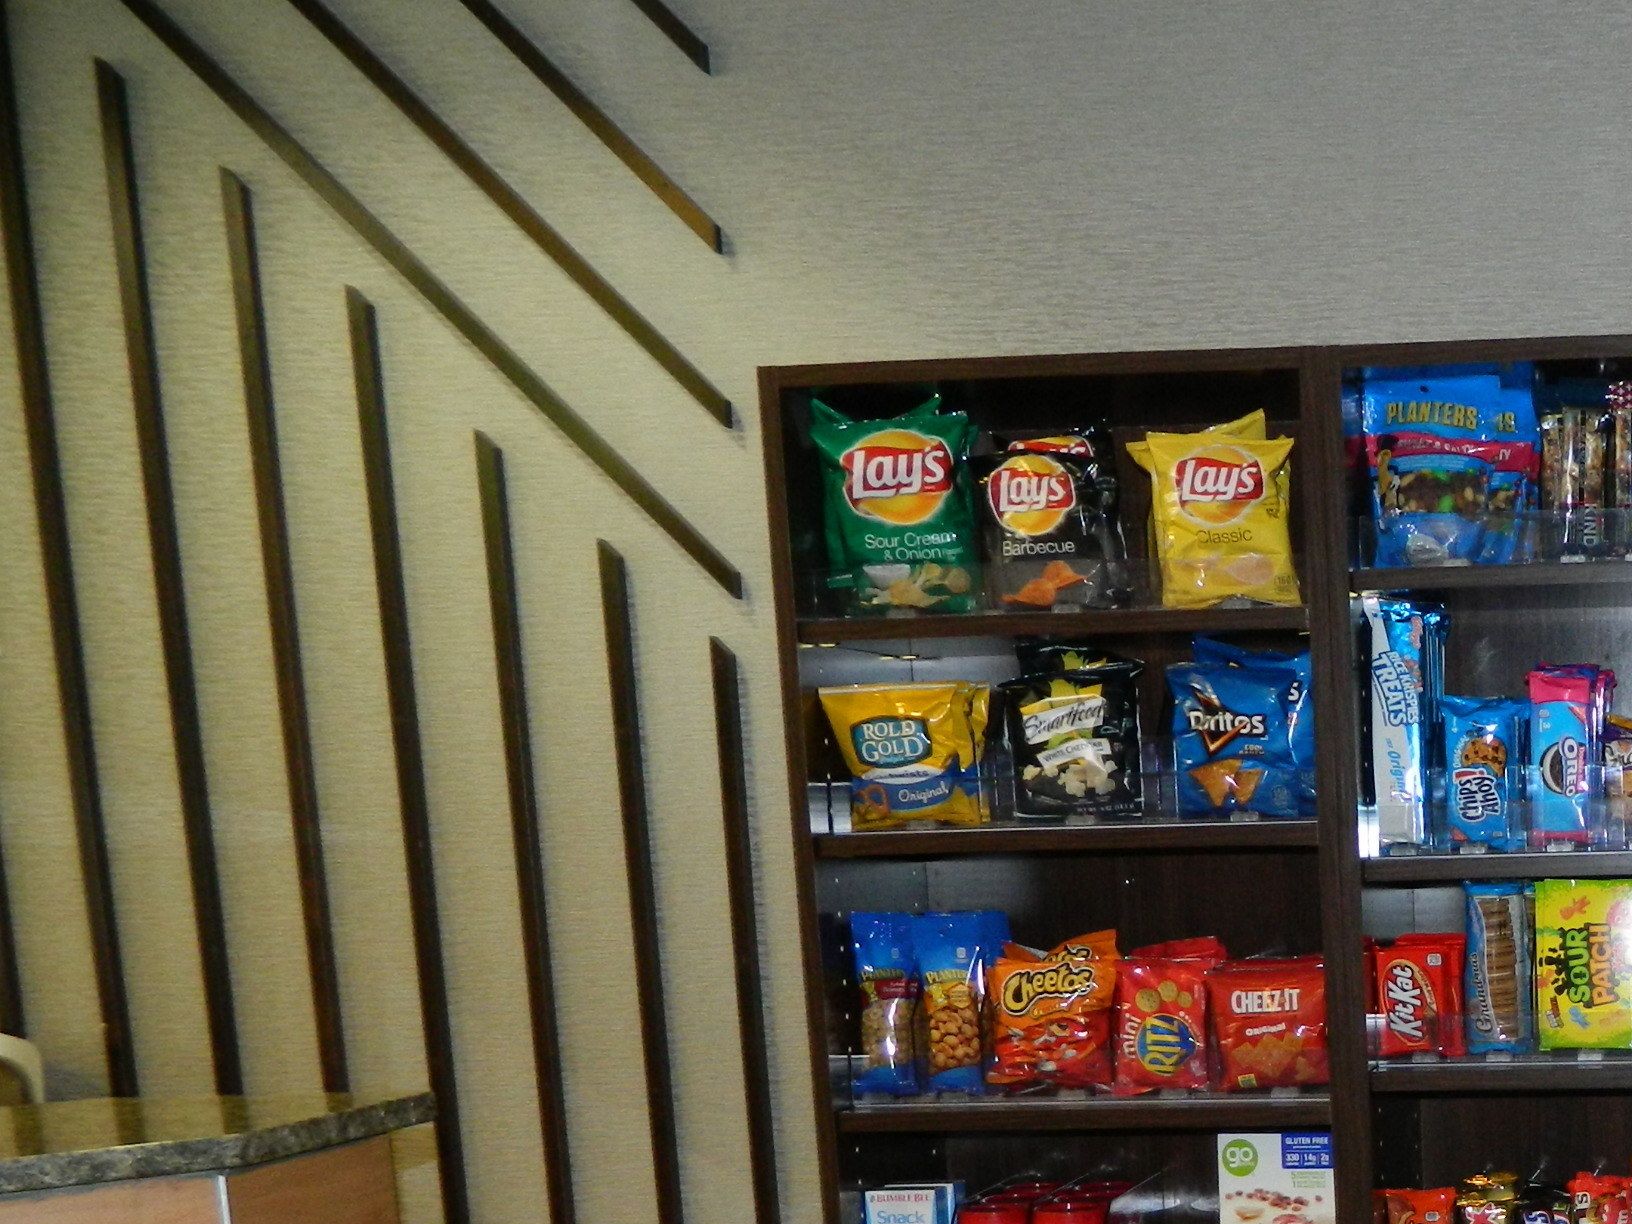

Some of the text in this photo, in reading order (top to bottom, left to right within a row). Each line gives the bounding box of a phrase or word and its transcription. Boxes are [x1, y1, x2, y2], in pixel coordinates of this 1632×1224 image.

[1386, 402, 1478, 430] PLANTERS
[853, 446, 945, 499] Lay's
[1181, 459, 1258, 502] Lay's
[864, 531, 957, 549] Sour Cream
[1002, 539, 1075, 556] Barbecue
[1196, 528, 1253, 544] Classic
[884, 550, 893, 560] &
[895, 547, 942, 561] Onion
[1372, 653, 1407, 727] TREATS
[862, 720, 915, 740] ROLD
[1188, 710, 1265, 734] Doritos
[861, 736, 924, 762] GOLD
[1564, 737, 1578, 796] OREO
[898, 780, 949, 803] Original
[1458, 777, 1485, 822] Chips
[1565, 929, 1592, 1003] SOUR
[1589, 923, 1615, 1006] PATCH
[1003, 963, 1094, 1014] Cheetos
[1120, 1013, 1142, 1059] mini
[1145, 1016, 1182, 1073] RITZ
[1285, 1136, 1329, 1145] GLUTEN FREE
[1226, 1146, 1254, 1168] go
[877, 1210, 926, 1224] Snack
